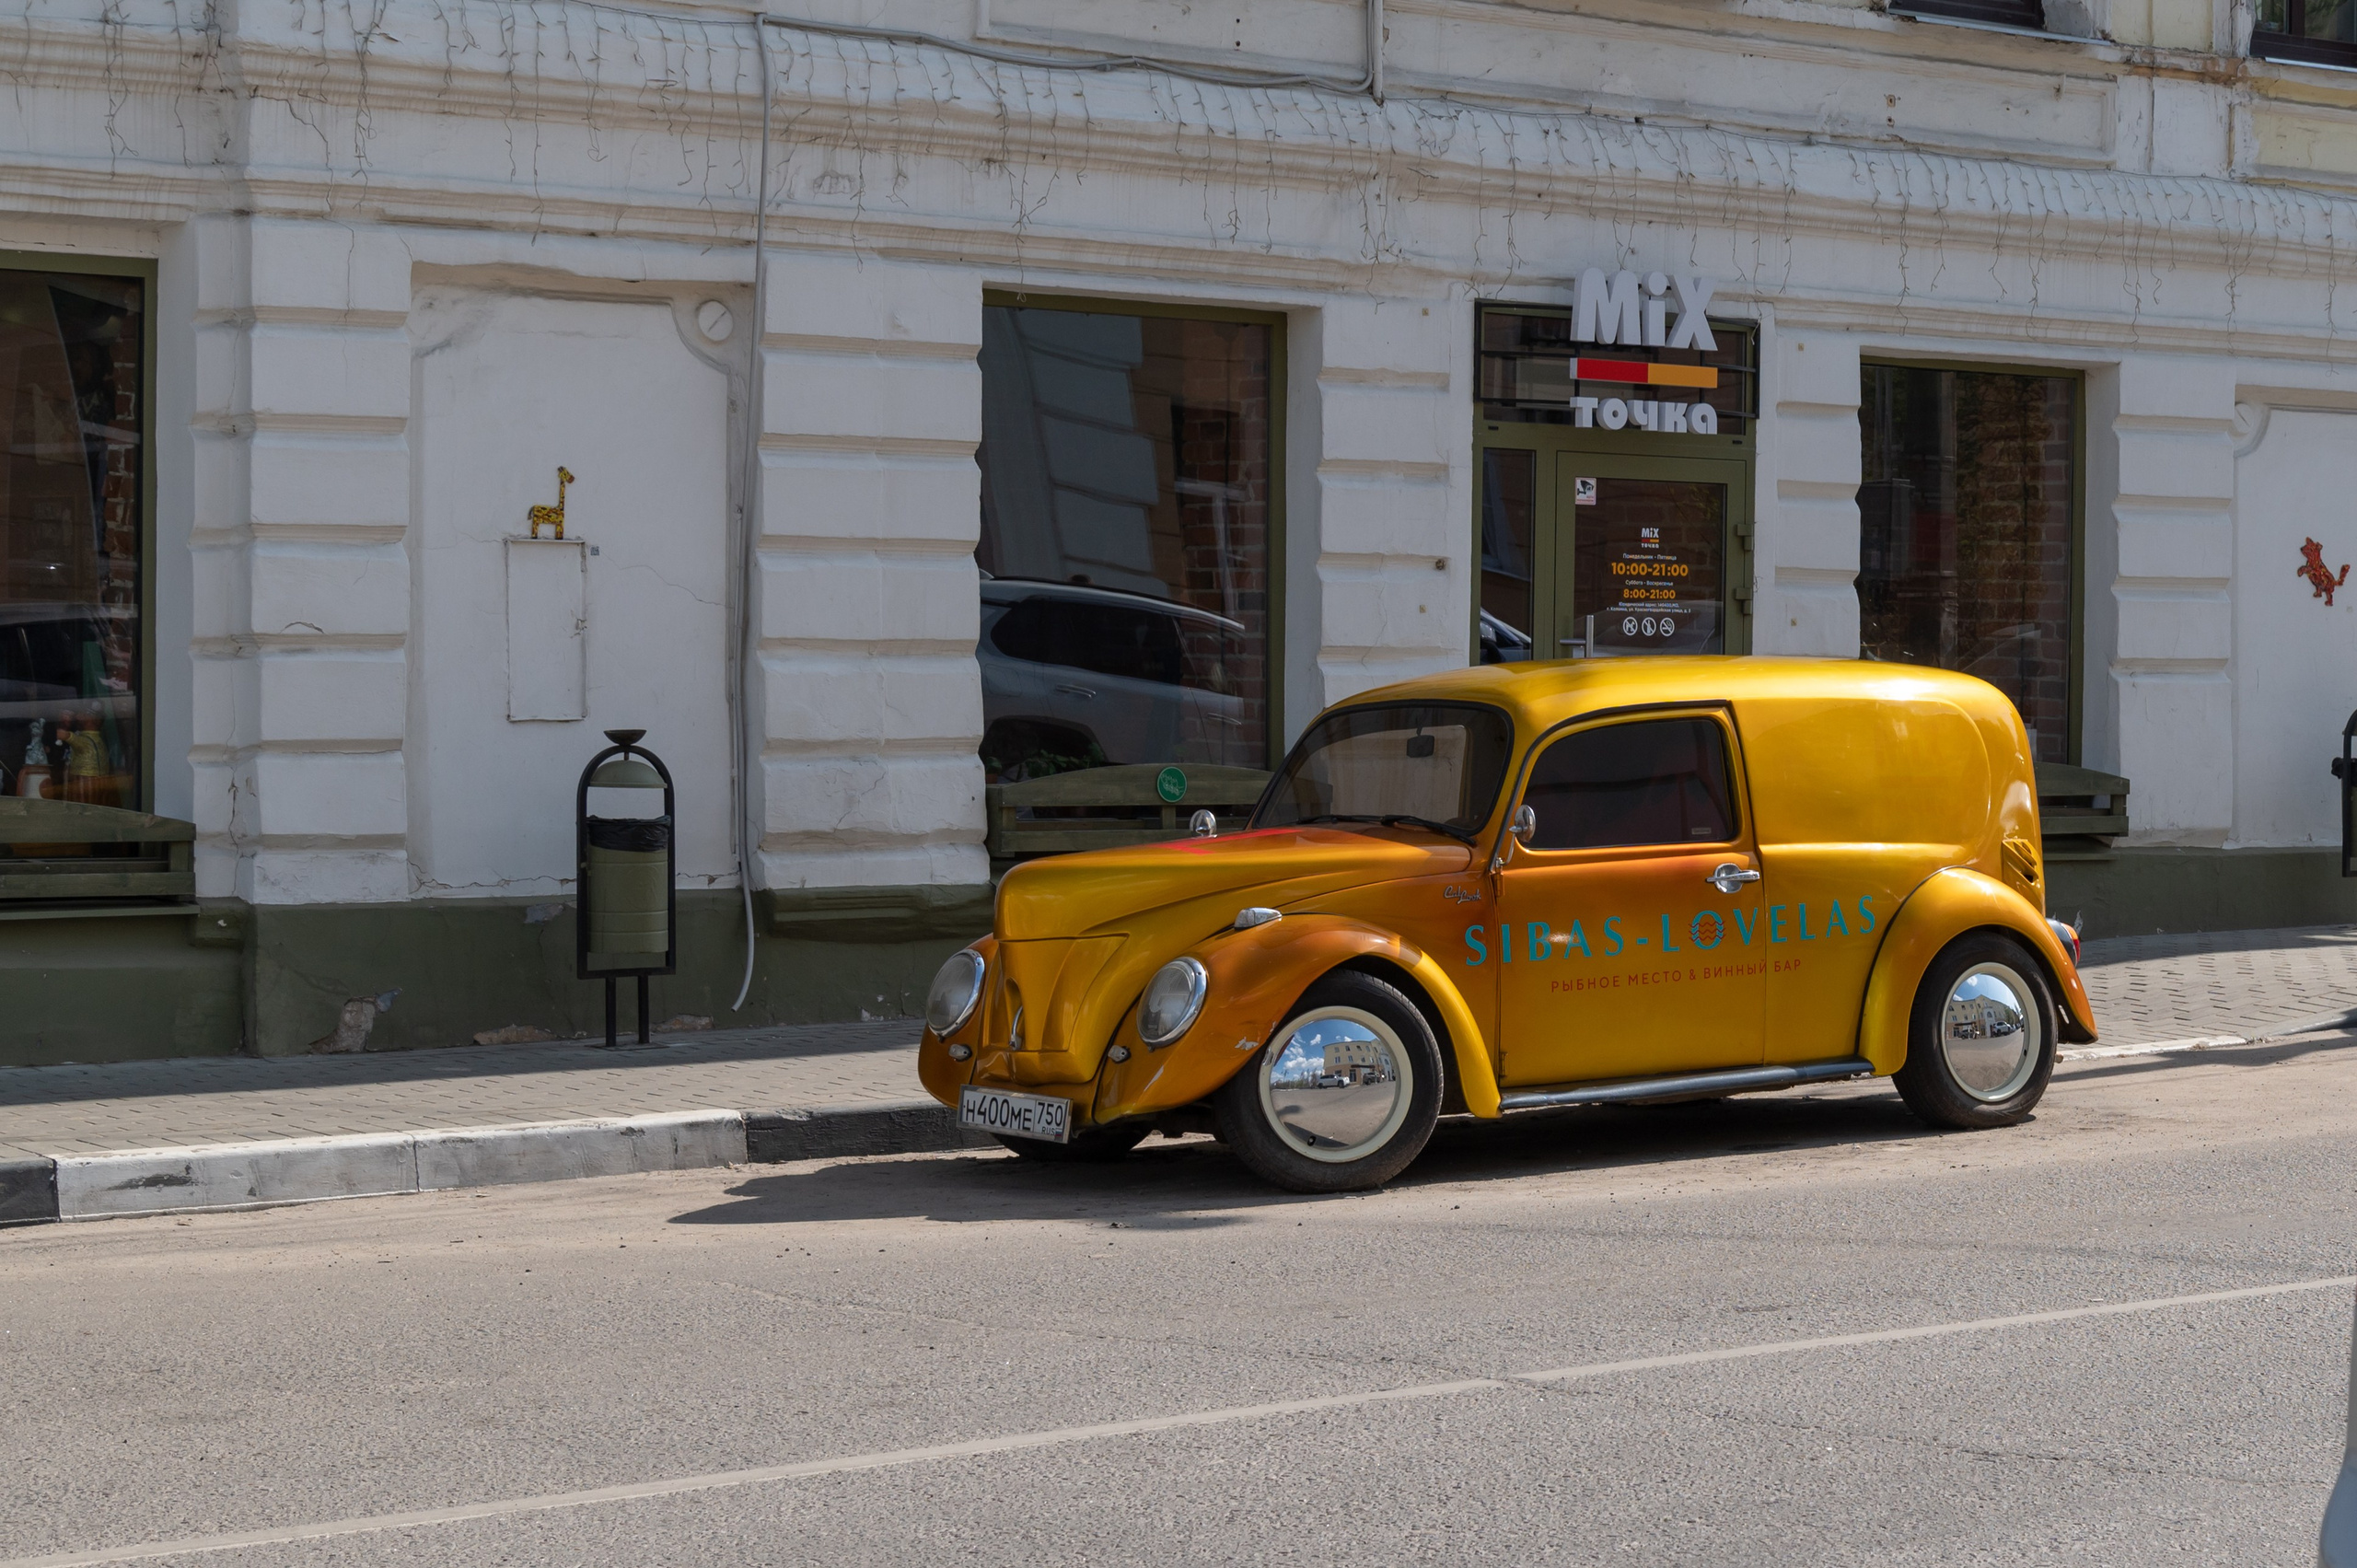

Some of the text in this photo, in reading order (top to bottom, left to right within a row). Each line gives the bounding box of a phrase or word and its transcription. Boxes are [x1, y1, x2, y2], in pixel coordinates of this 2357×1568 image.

[1611, 562, 1689, 576] 10:00-21:00
[1623, 588, 1676, 599] 8:00-21:00
[1444, 885, 1461, 899] Cal
[1457, 889, 1481, 904] Look
[1465, 895, 1876, 967] SIBAS-LOVELAS
[1550, 958, 1801, 993] РЫБНОЕ МЕСТО & ВИННЫЙ БАР
[1038, 1102, 1063, 1126] 750
[1041, 1126, 1055, 1136] RUS
